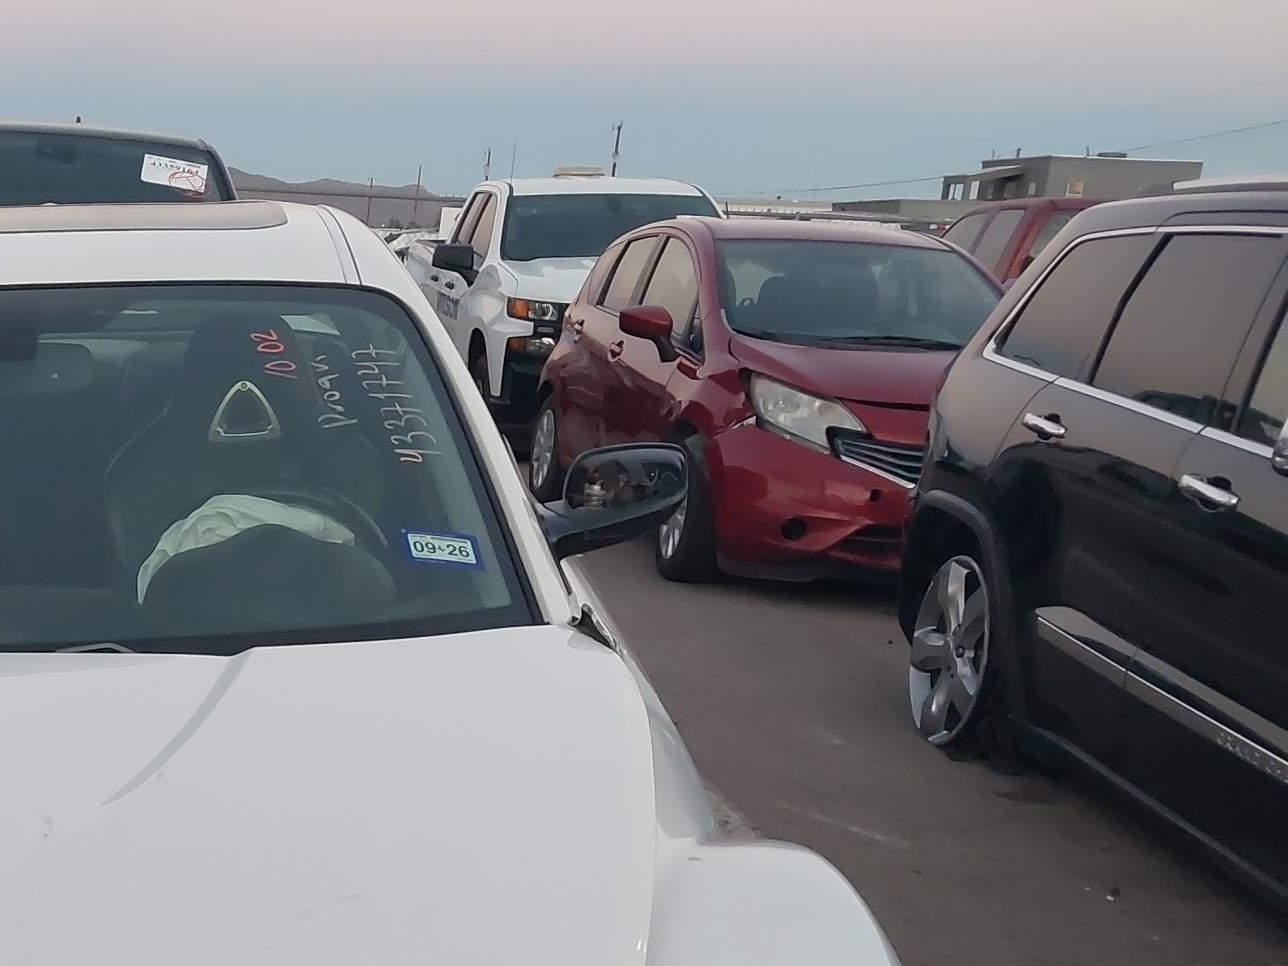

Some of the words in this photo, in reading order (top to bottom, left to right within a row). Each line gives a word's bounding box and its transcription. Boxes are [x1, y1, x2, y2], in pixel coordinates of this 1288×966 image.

[351, 343, 444, 464] 43371747
[413, 540, 437, 554] 09
[446, 543, 470, 558] 26
